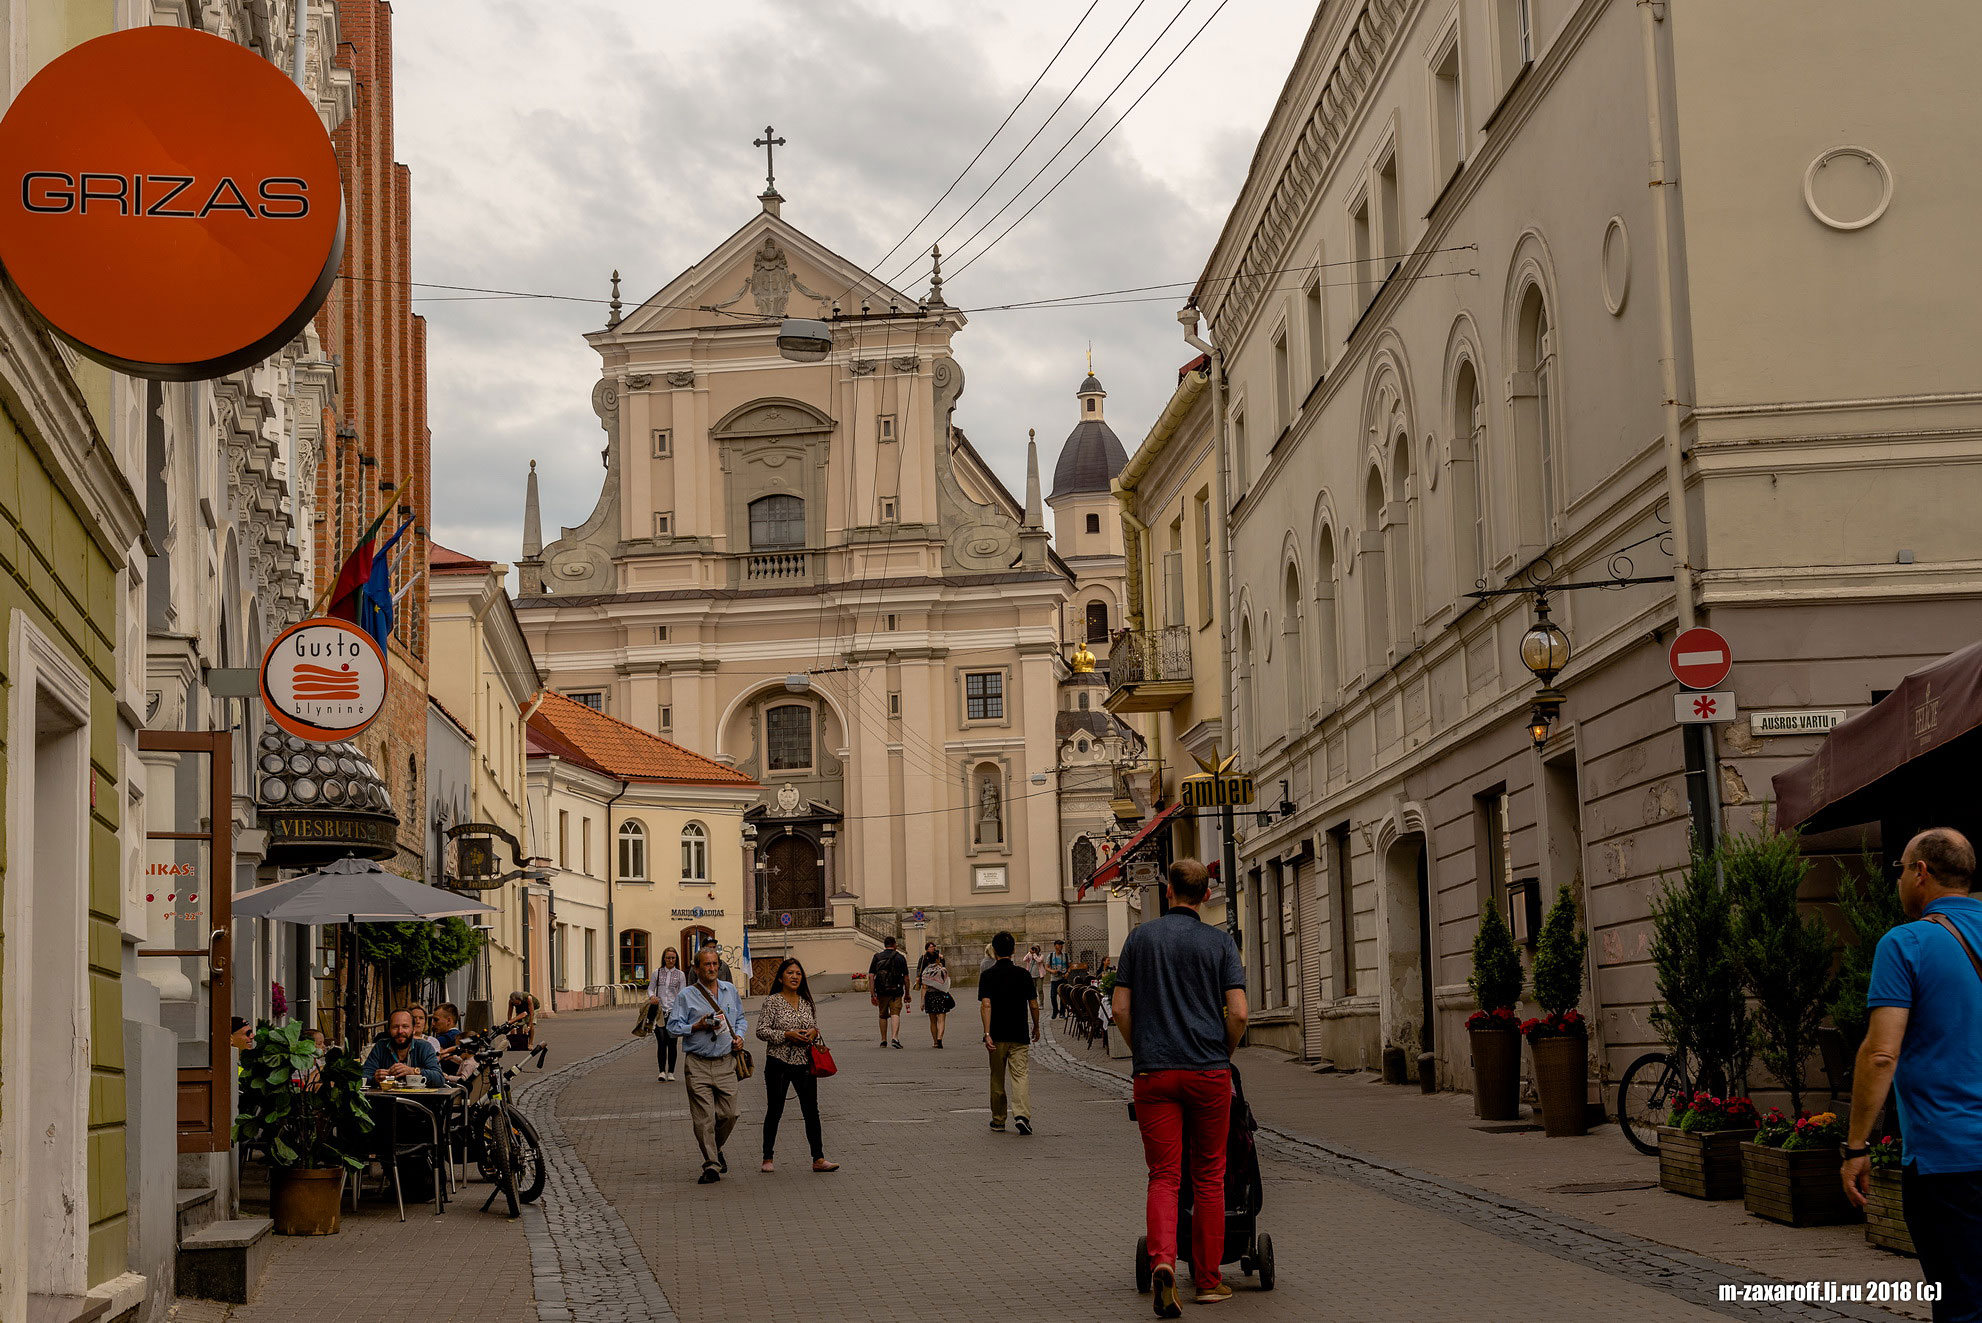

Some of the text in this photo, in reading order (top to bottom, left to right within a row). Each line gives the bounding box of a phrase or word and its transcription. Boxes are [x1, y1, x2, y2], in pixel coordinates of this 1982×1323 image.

[21, 170, 311, 220] GRIZAS
[295, 632, 360, 657] Gusto
[1181, 771, 1253, 806] amber
[281, 819, 368, 839] VIESBUTIS
[145, 863, 195, 876] IKAS:
